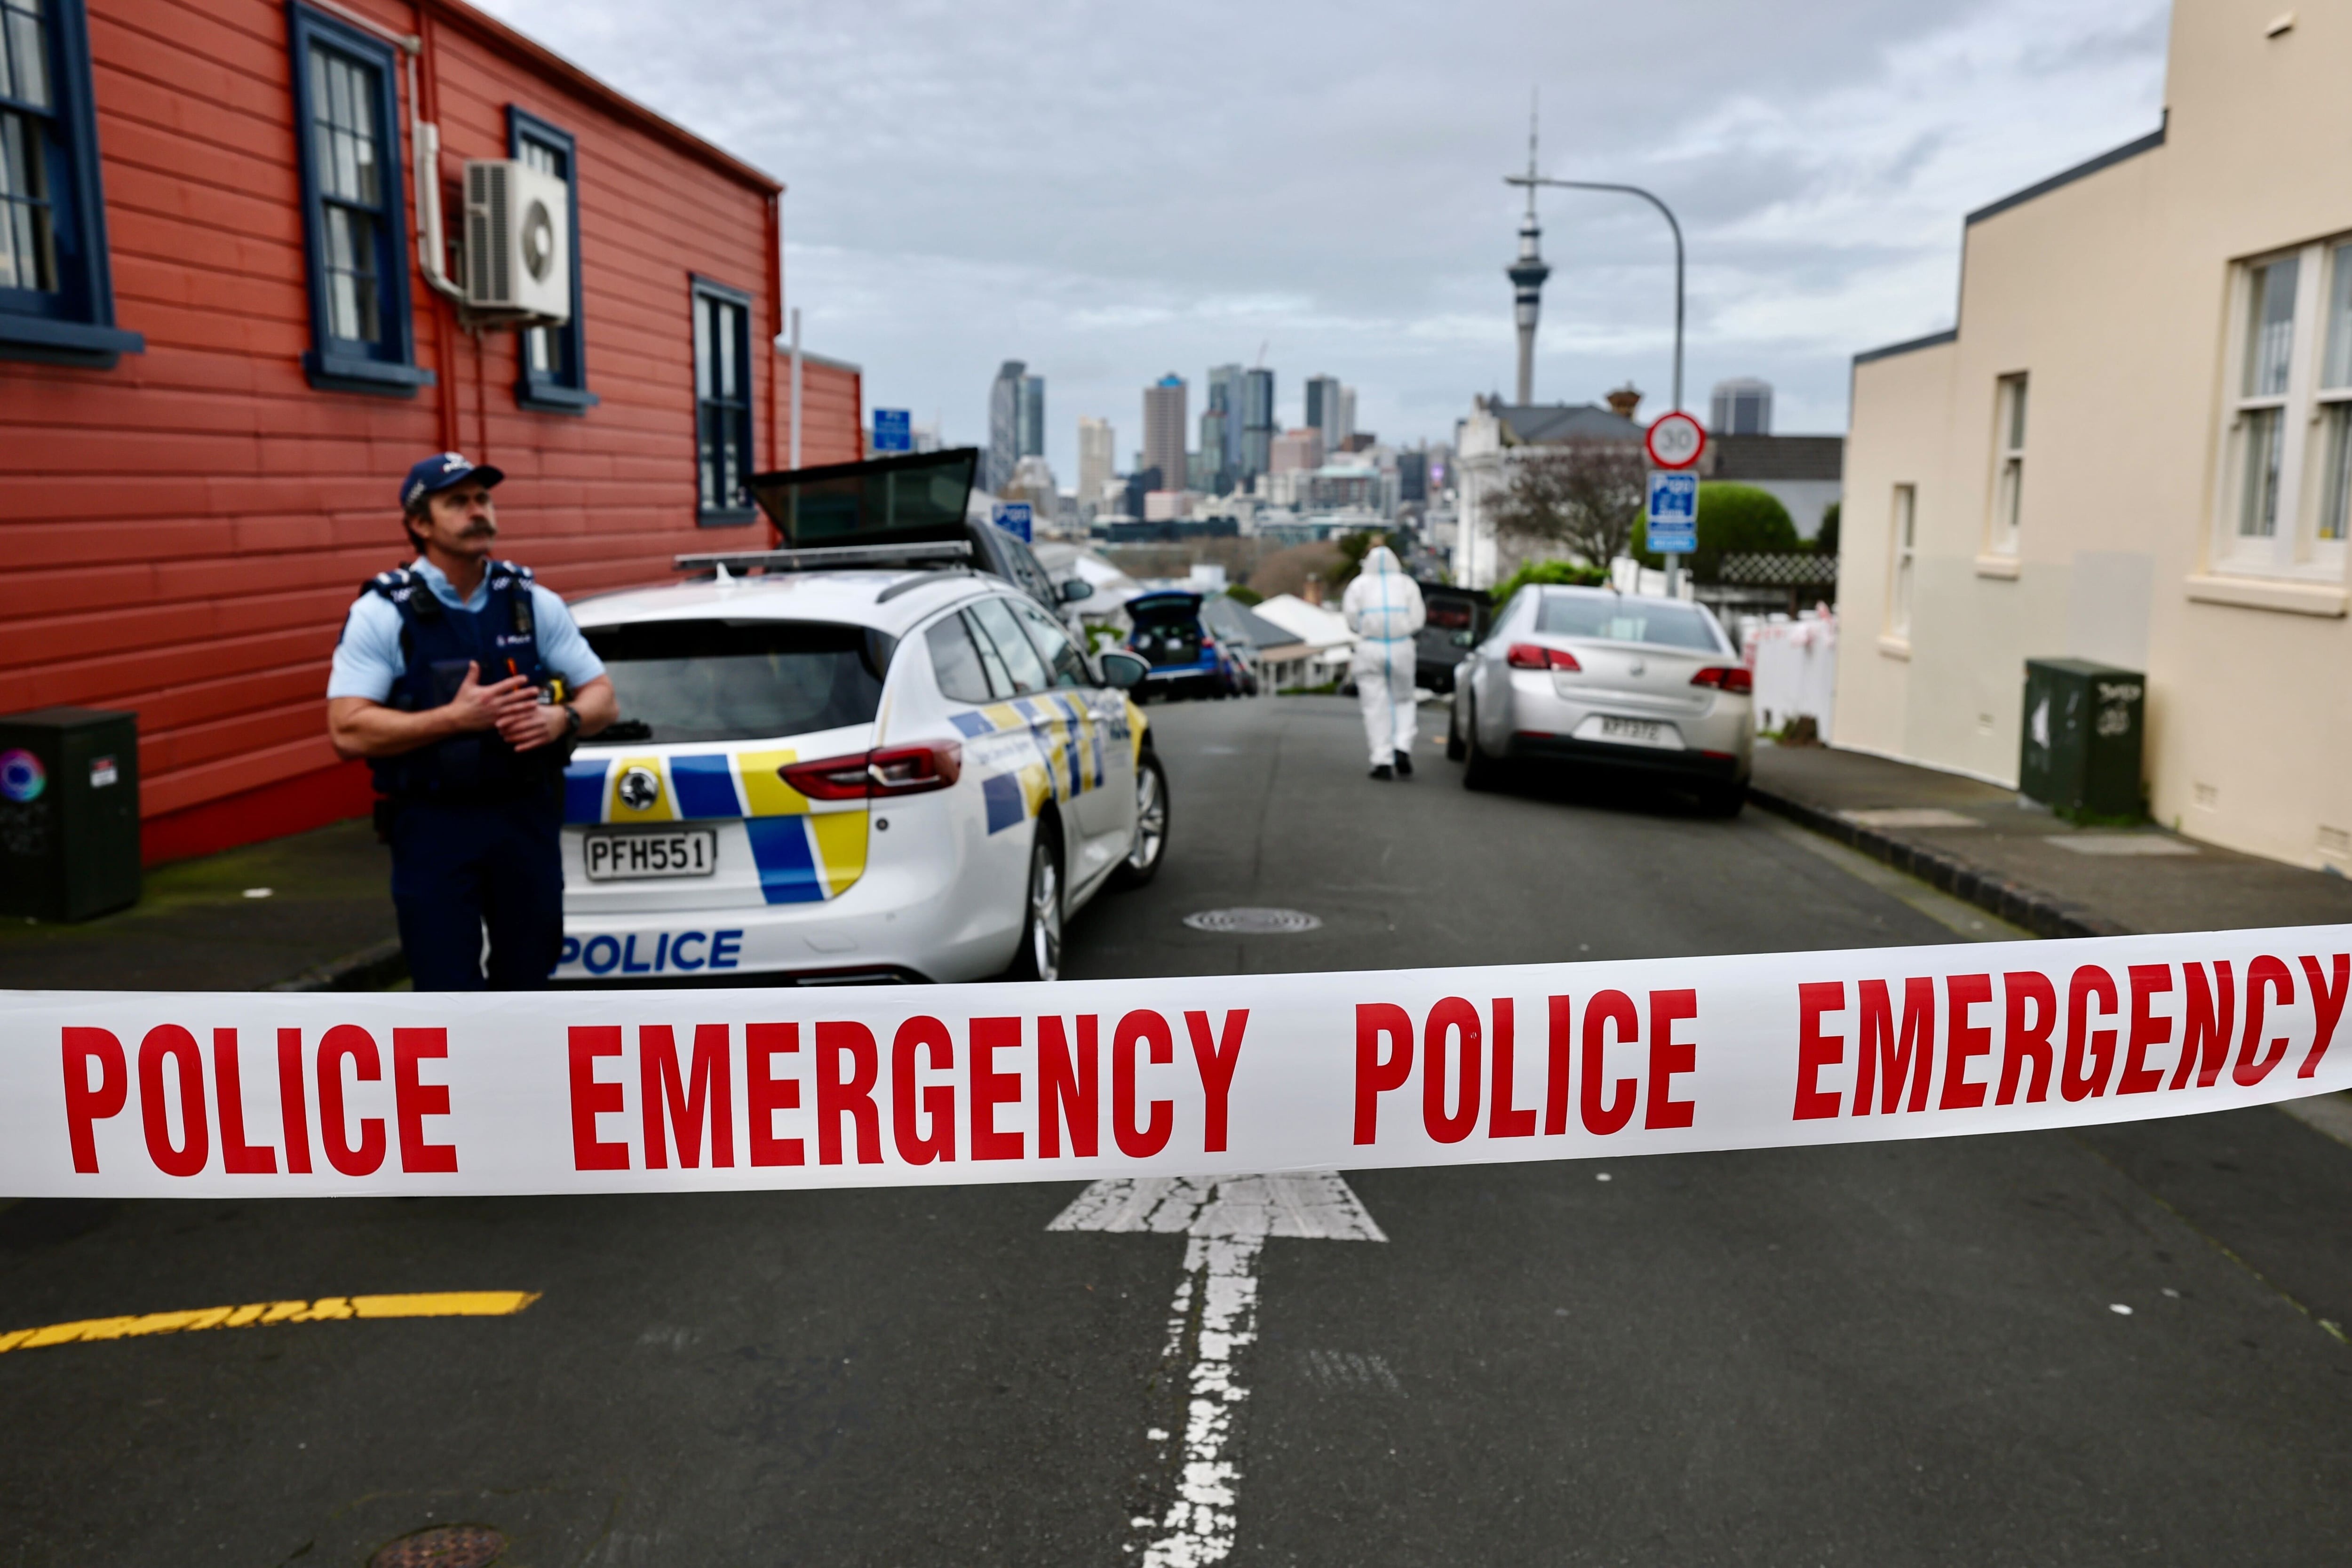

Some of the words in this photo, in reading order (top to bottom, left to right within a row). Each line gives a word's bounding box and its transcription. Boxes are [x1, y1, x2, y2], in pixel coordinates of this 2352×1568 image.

[1660, 428, 1693, 451] 30
[591, 837, 704, 872] PFH551
[548, 929, 743, 976] POLICE
[62, 1024, 458, 1177] POLICE
[568, 1009, 1249, 1171] EMERGENCY
[1354, 989, 1697, 1145] POLICE
[1793, 954, 2351, 1120] EMERGENCY
